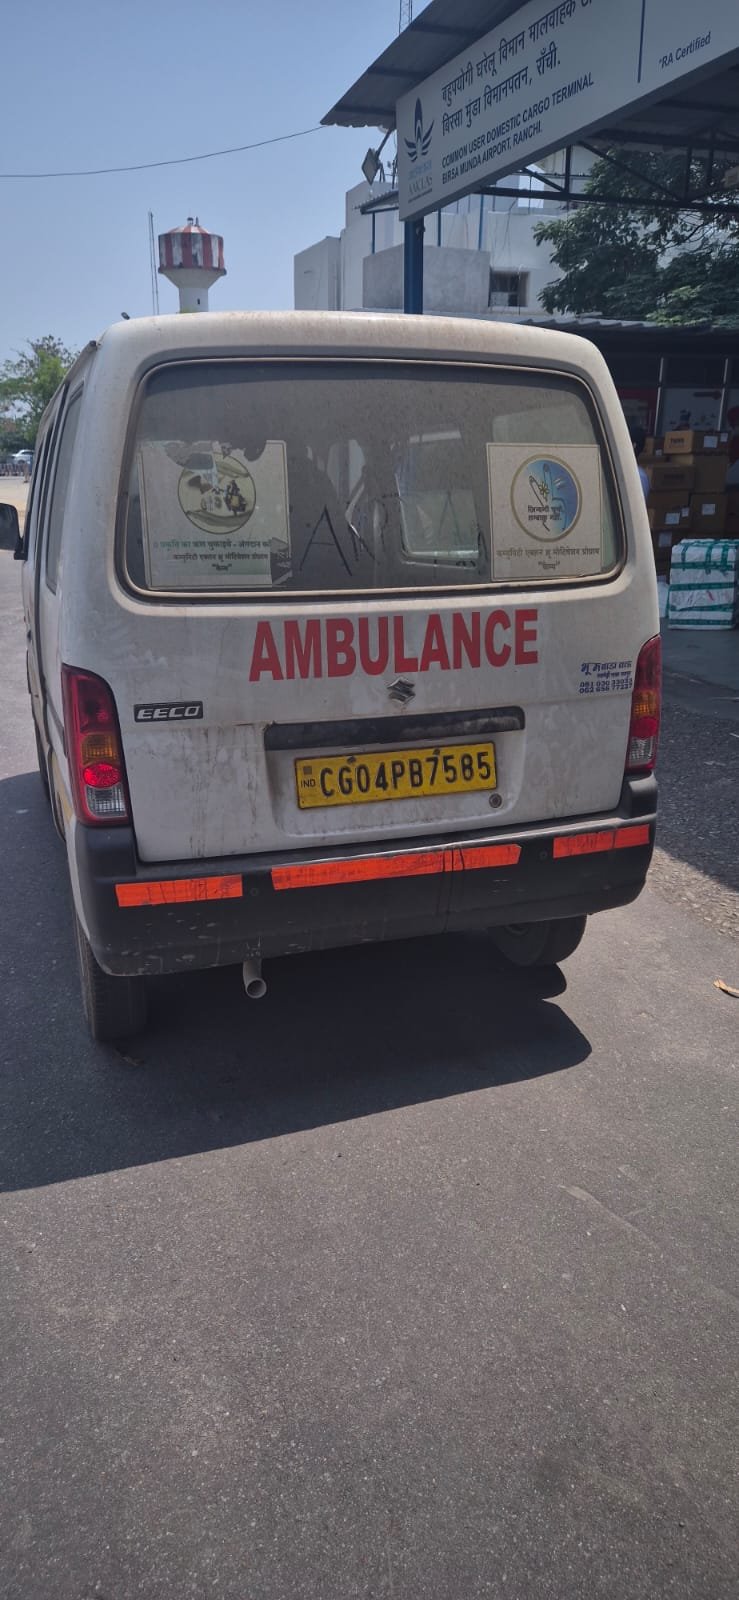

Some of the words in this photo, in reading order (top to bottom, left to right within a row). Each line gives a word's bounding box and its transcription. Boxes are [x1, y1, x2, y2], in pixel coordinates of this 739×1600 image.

[476, 52, 497, 78] घरेलू
[499, 30, 525, 64] विमान
[528, 0, 576, 43] मालवाहक
[675, 31, 711, 61] Certified
[442, 109, 463, 136] बिरसा
[465, 97, 481, 128] मुंडा
[483, 66, 532, 110] विमानपतन,
[442, 143, 467, 168] COMMON
[468, 134, 486, 154] USER
[486, 113, 521, 143] DOMESTIC
[522, 96, 550, 122] CARGO
[552, 72, 594, 106] TERMINAL
[442, 167, 459, 184] BIRSA
[460, 154, 481, 175] MUNDA
[482, 137, 511, 163] AIRPORT,
[513, 120, 542, 147] RANCHI.
[249, 608, 538, 682] AMBULANCE
[136, 706, 201, 719] EECO
[300, 778, 316, 789] IND
[320, 751, 492, 797] CG04PB7585
